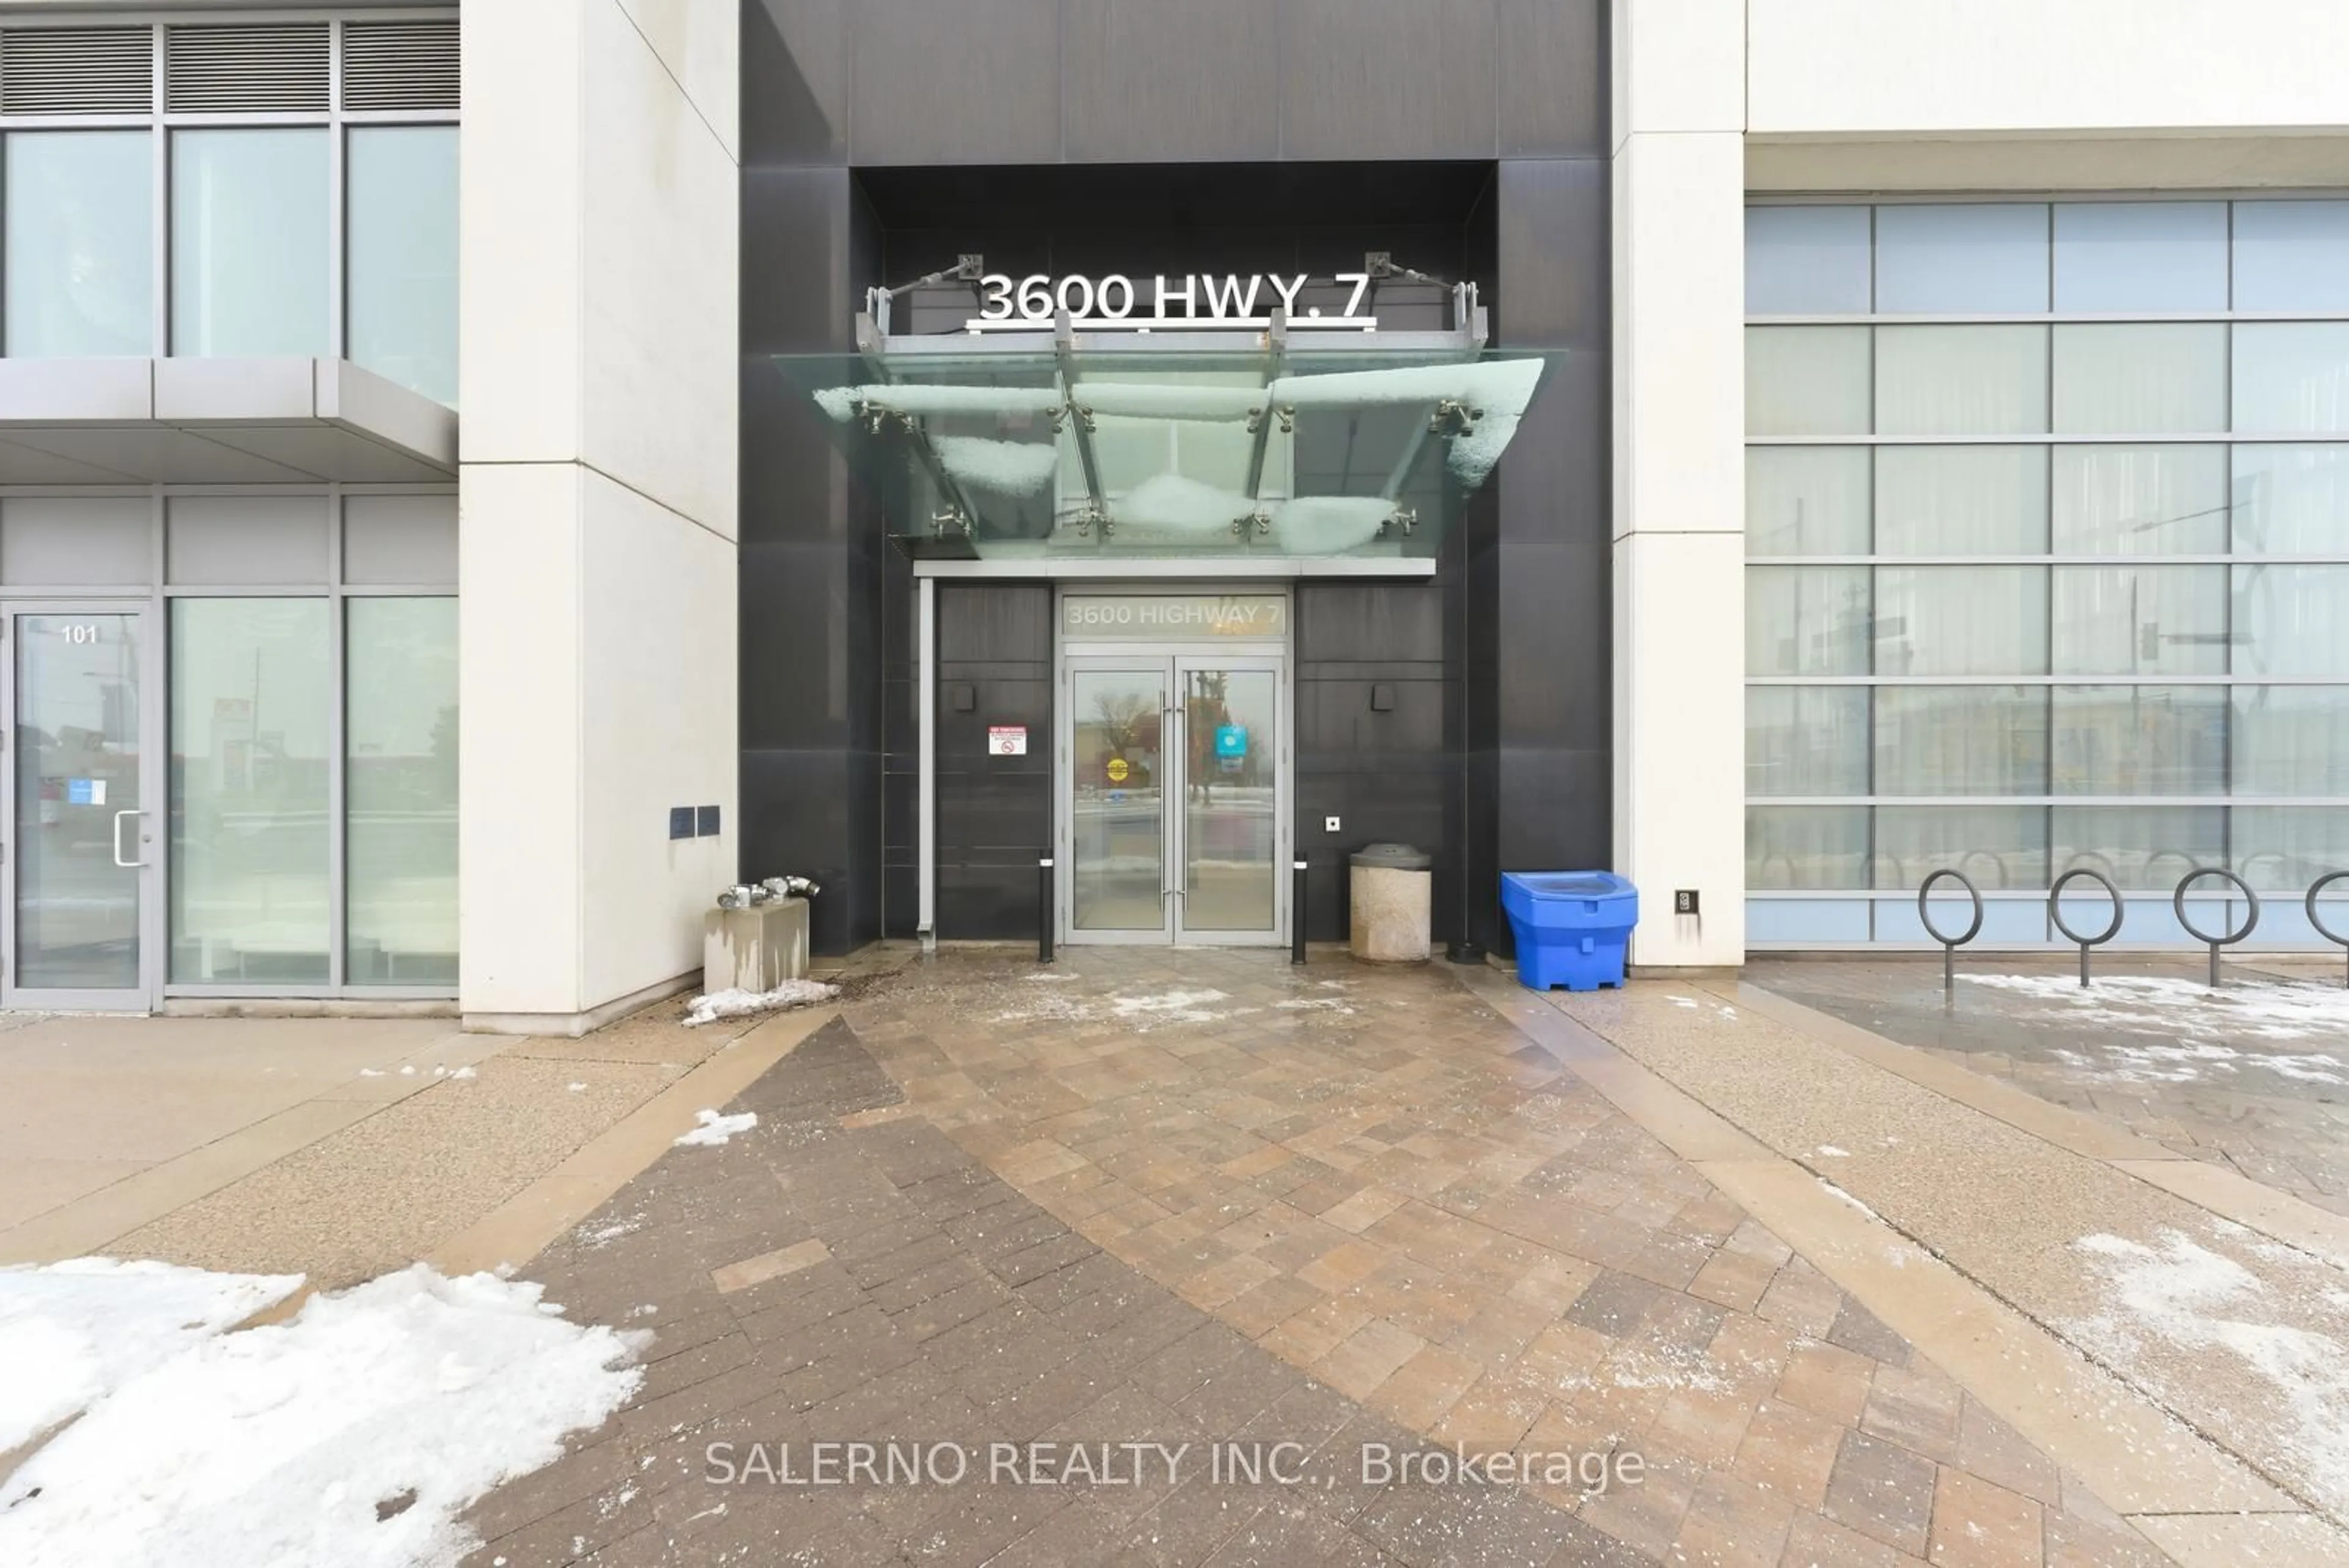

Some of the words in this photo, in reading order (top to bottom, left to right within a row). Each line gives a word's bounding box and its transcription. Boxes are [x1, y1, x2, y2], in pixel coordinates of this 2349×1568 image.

[980, 274, 1135, 319] 3600
[1155, 274, 1320, 318] HWY.
[1336, 273, 1369, 317] 7
[1069, 605, 1131, 624] 3600
[1140, 605, 1259, 624] HIGHWAY
[1267, 605, 1280, 624] 7
[62, 625, 95, 644] 101
